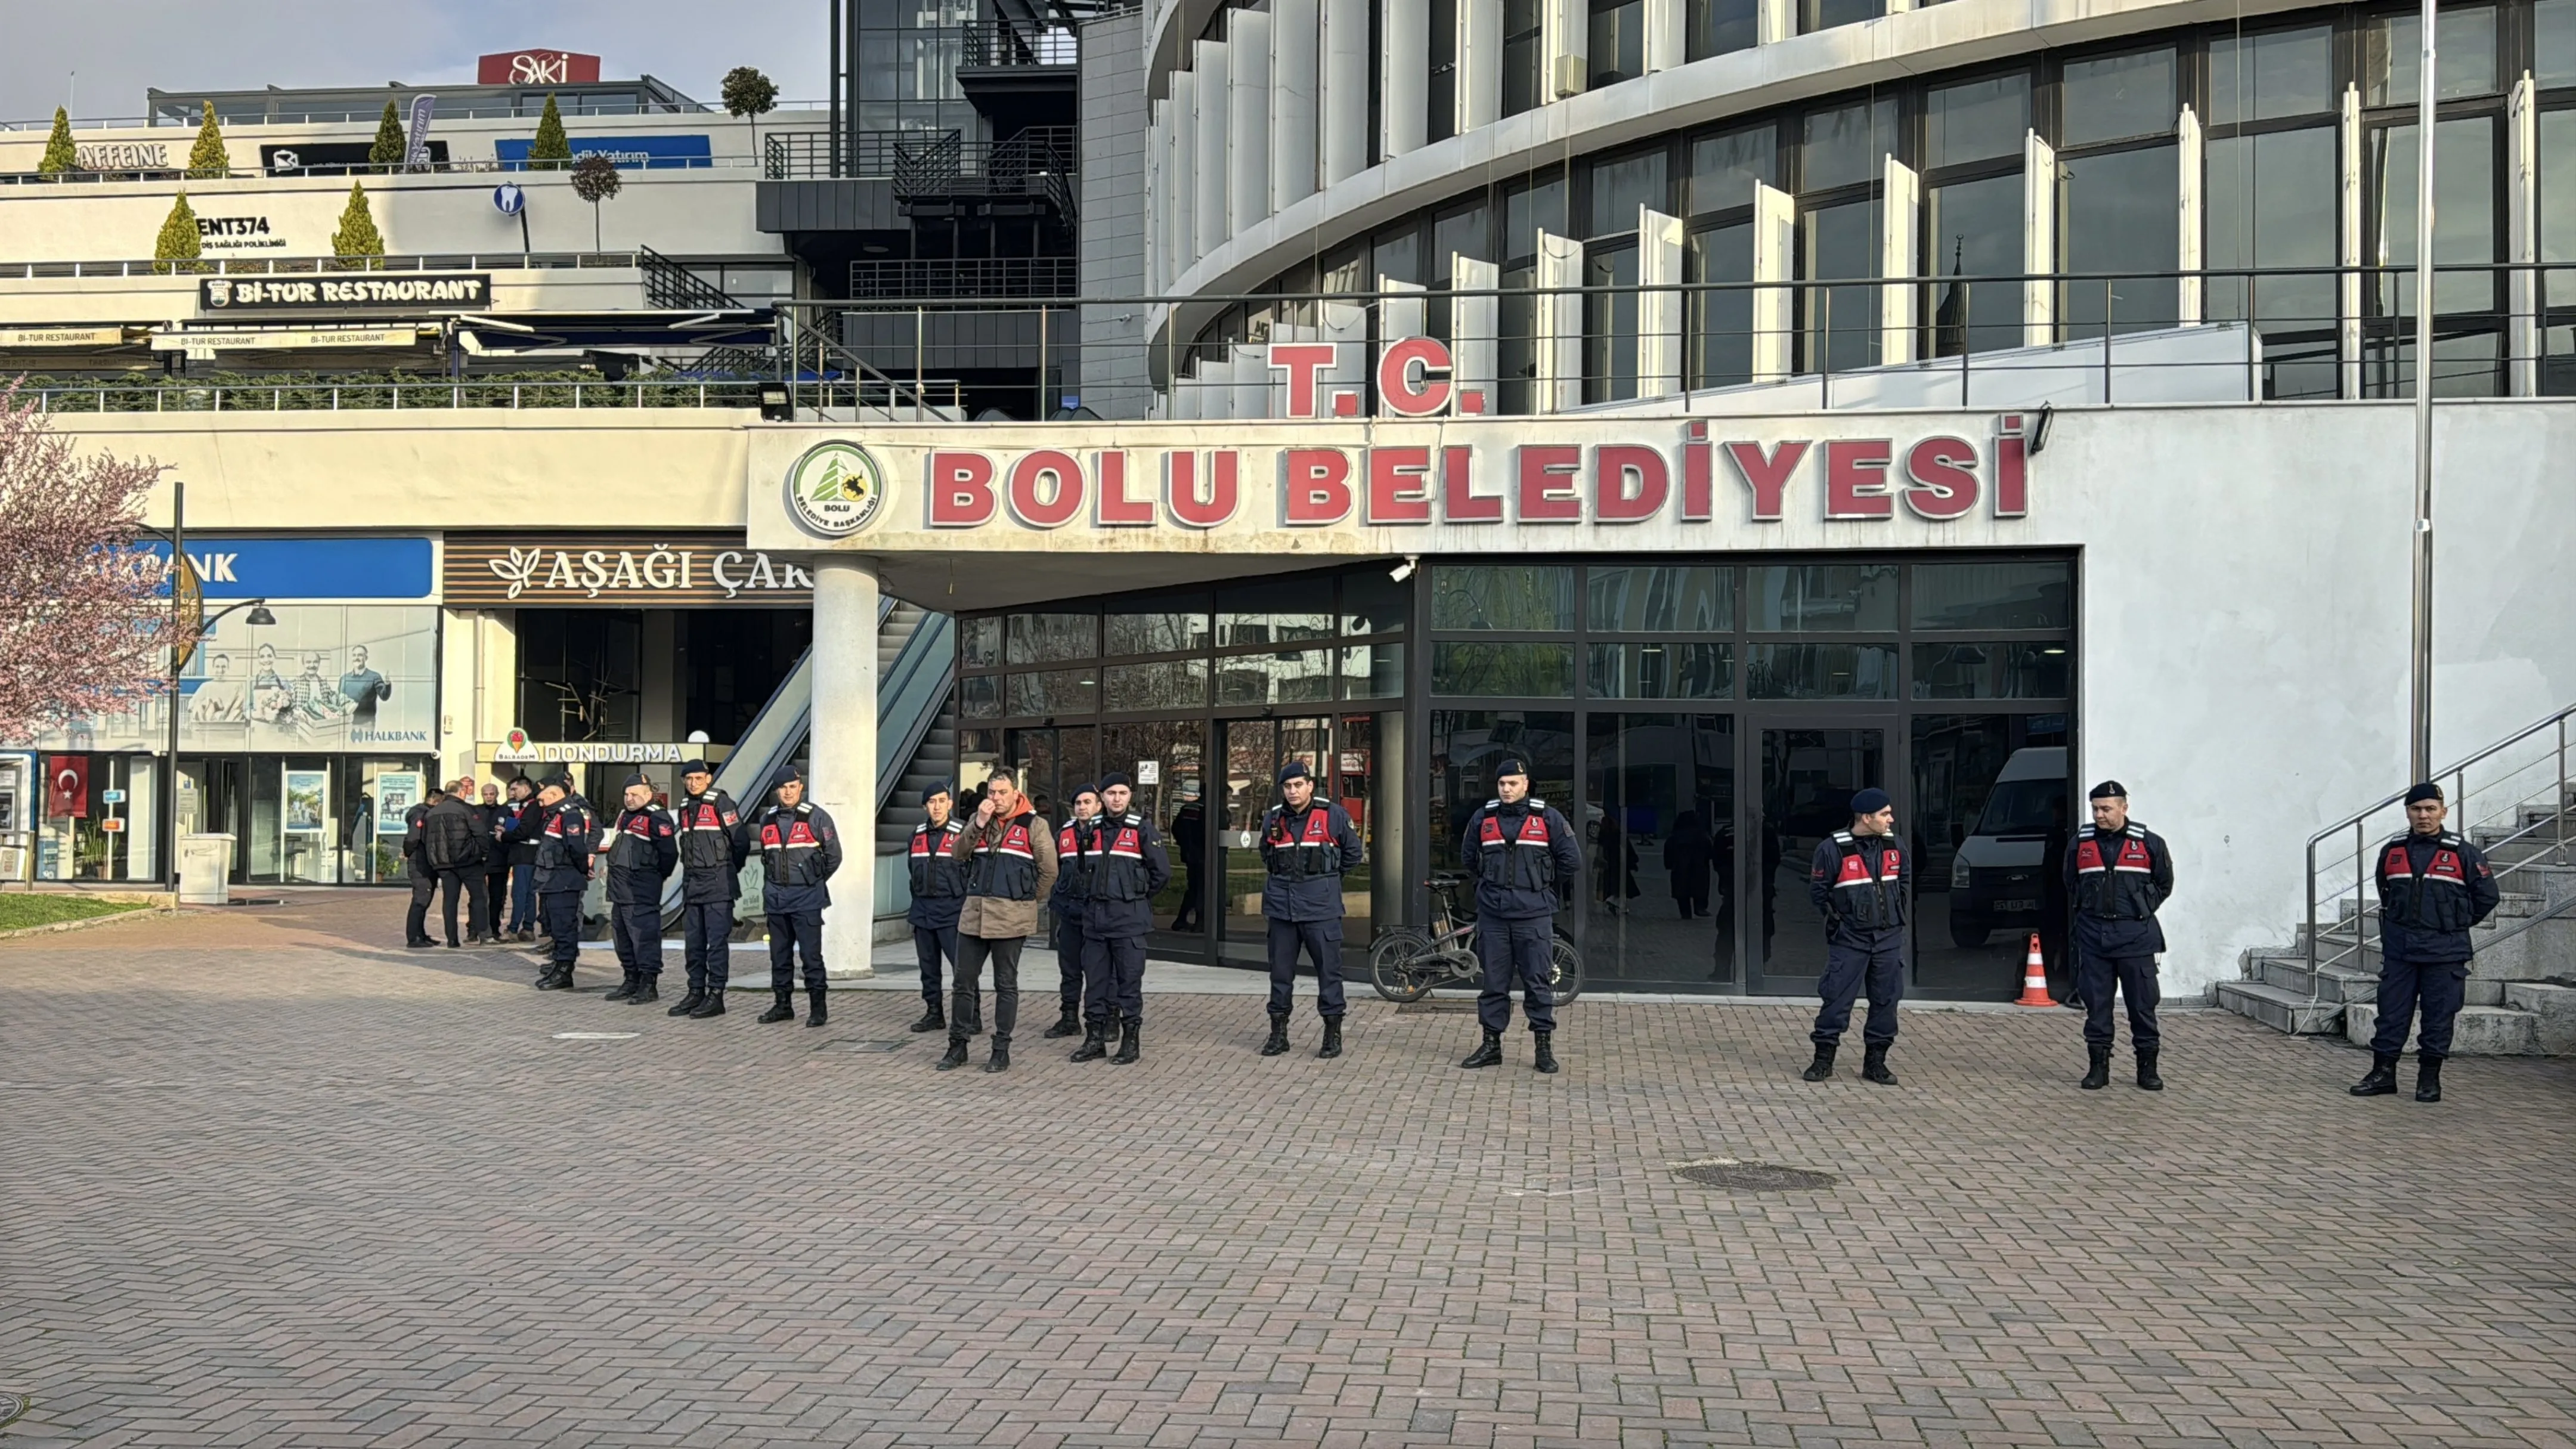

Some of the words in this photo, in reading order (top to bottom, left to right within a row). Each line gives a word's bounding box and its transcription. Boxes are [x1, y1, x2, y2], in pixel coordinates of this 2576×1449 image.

[77, 144, 169, 168] AFFEINE
[196, 216, 270, 236] ENT374
[202, 240, 213, 249] DİŞ
[215, 240, 242, 249] SAĞLIĞI
[244, 238, 286, 248] POLİKLİNİĞİ
[236, 281, 317, 303] Bİ-TUR
[320, 280, 482, 302] RESTAURANT
[45, 333, 96, 341] RESTAURANT
[208, 337, 256, 345] RESTAURANT
[337, 334, 385, 342] RESTAURANT
[930, 447, 1241, 528] BOLU
[1284, 413, 2028, 526] BELEDİYESİ
[797, 496, 829, 527] BELEDİYE
[834, 497, 877, 527] BAŞKANLIĞI
[545, 544, 693, 598] AŞAĞI
[365, 730, 427, 741] HALKBANK
[545, 743, 682, 762] DONDURMA
